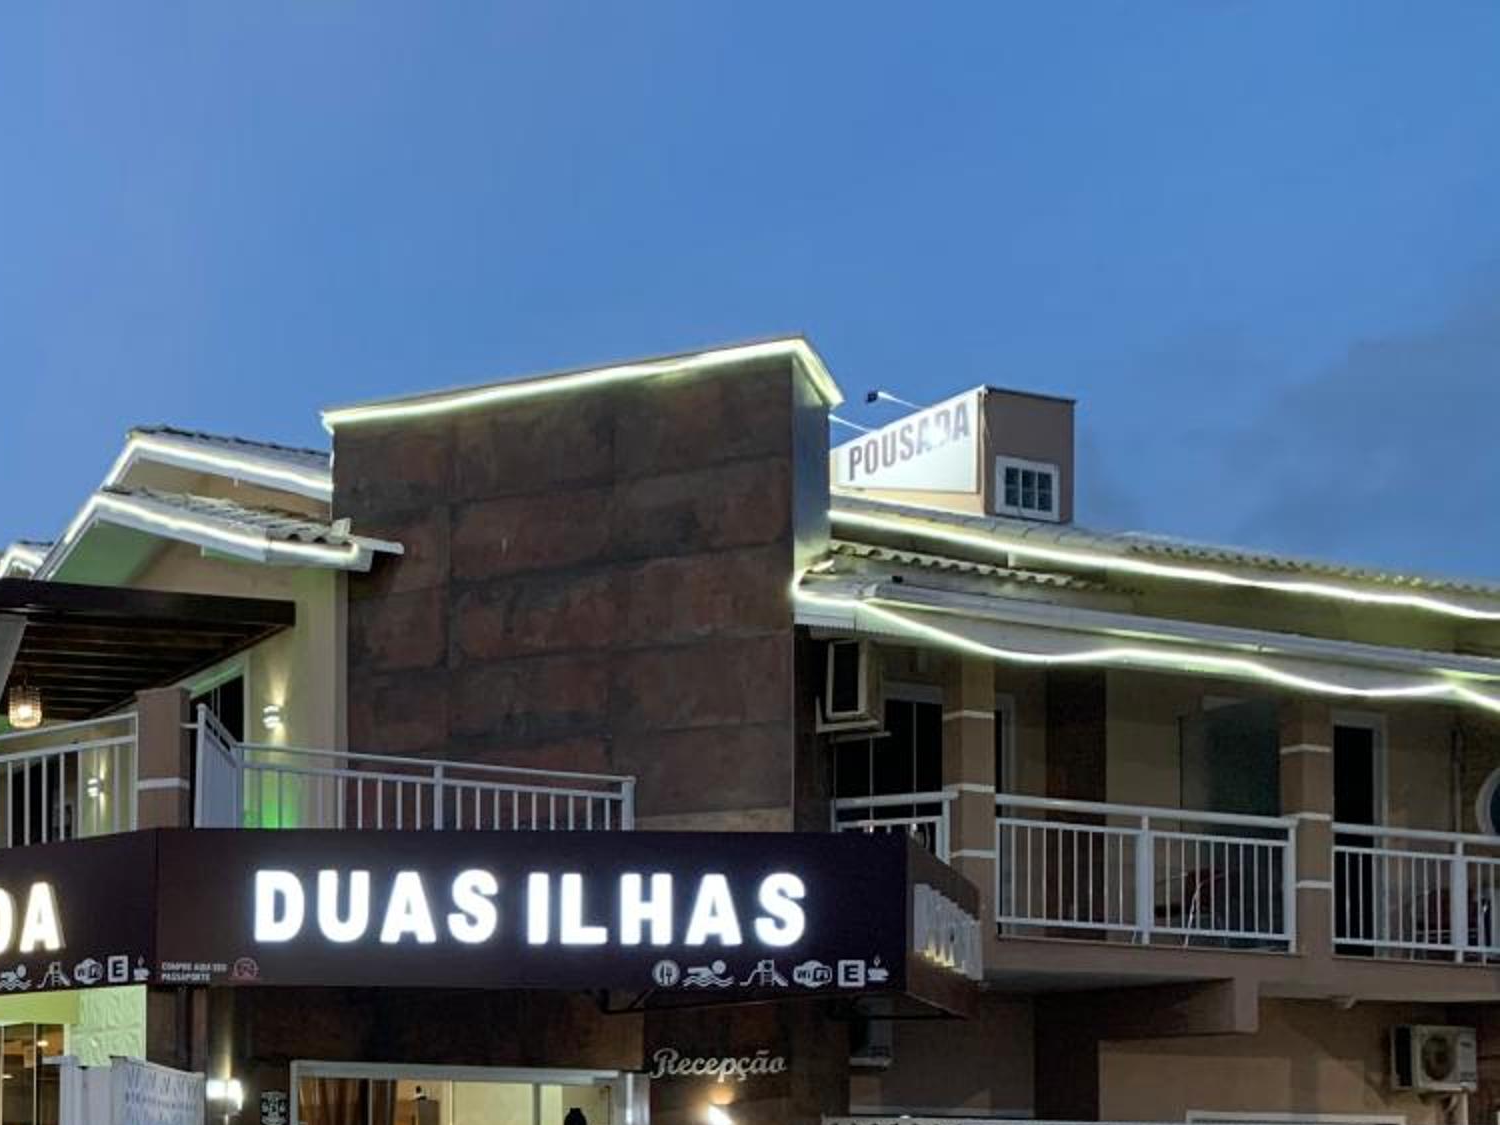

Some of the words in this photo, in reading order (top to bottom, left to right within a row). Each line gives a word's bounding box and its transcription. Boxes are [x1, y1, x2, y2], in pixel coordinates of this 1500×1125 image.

[254, 869, 500, 945] DUAS
[526, 872, 806, 947] ILHAS
[650, 1047, 788, 1084] Recepção
